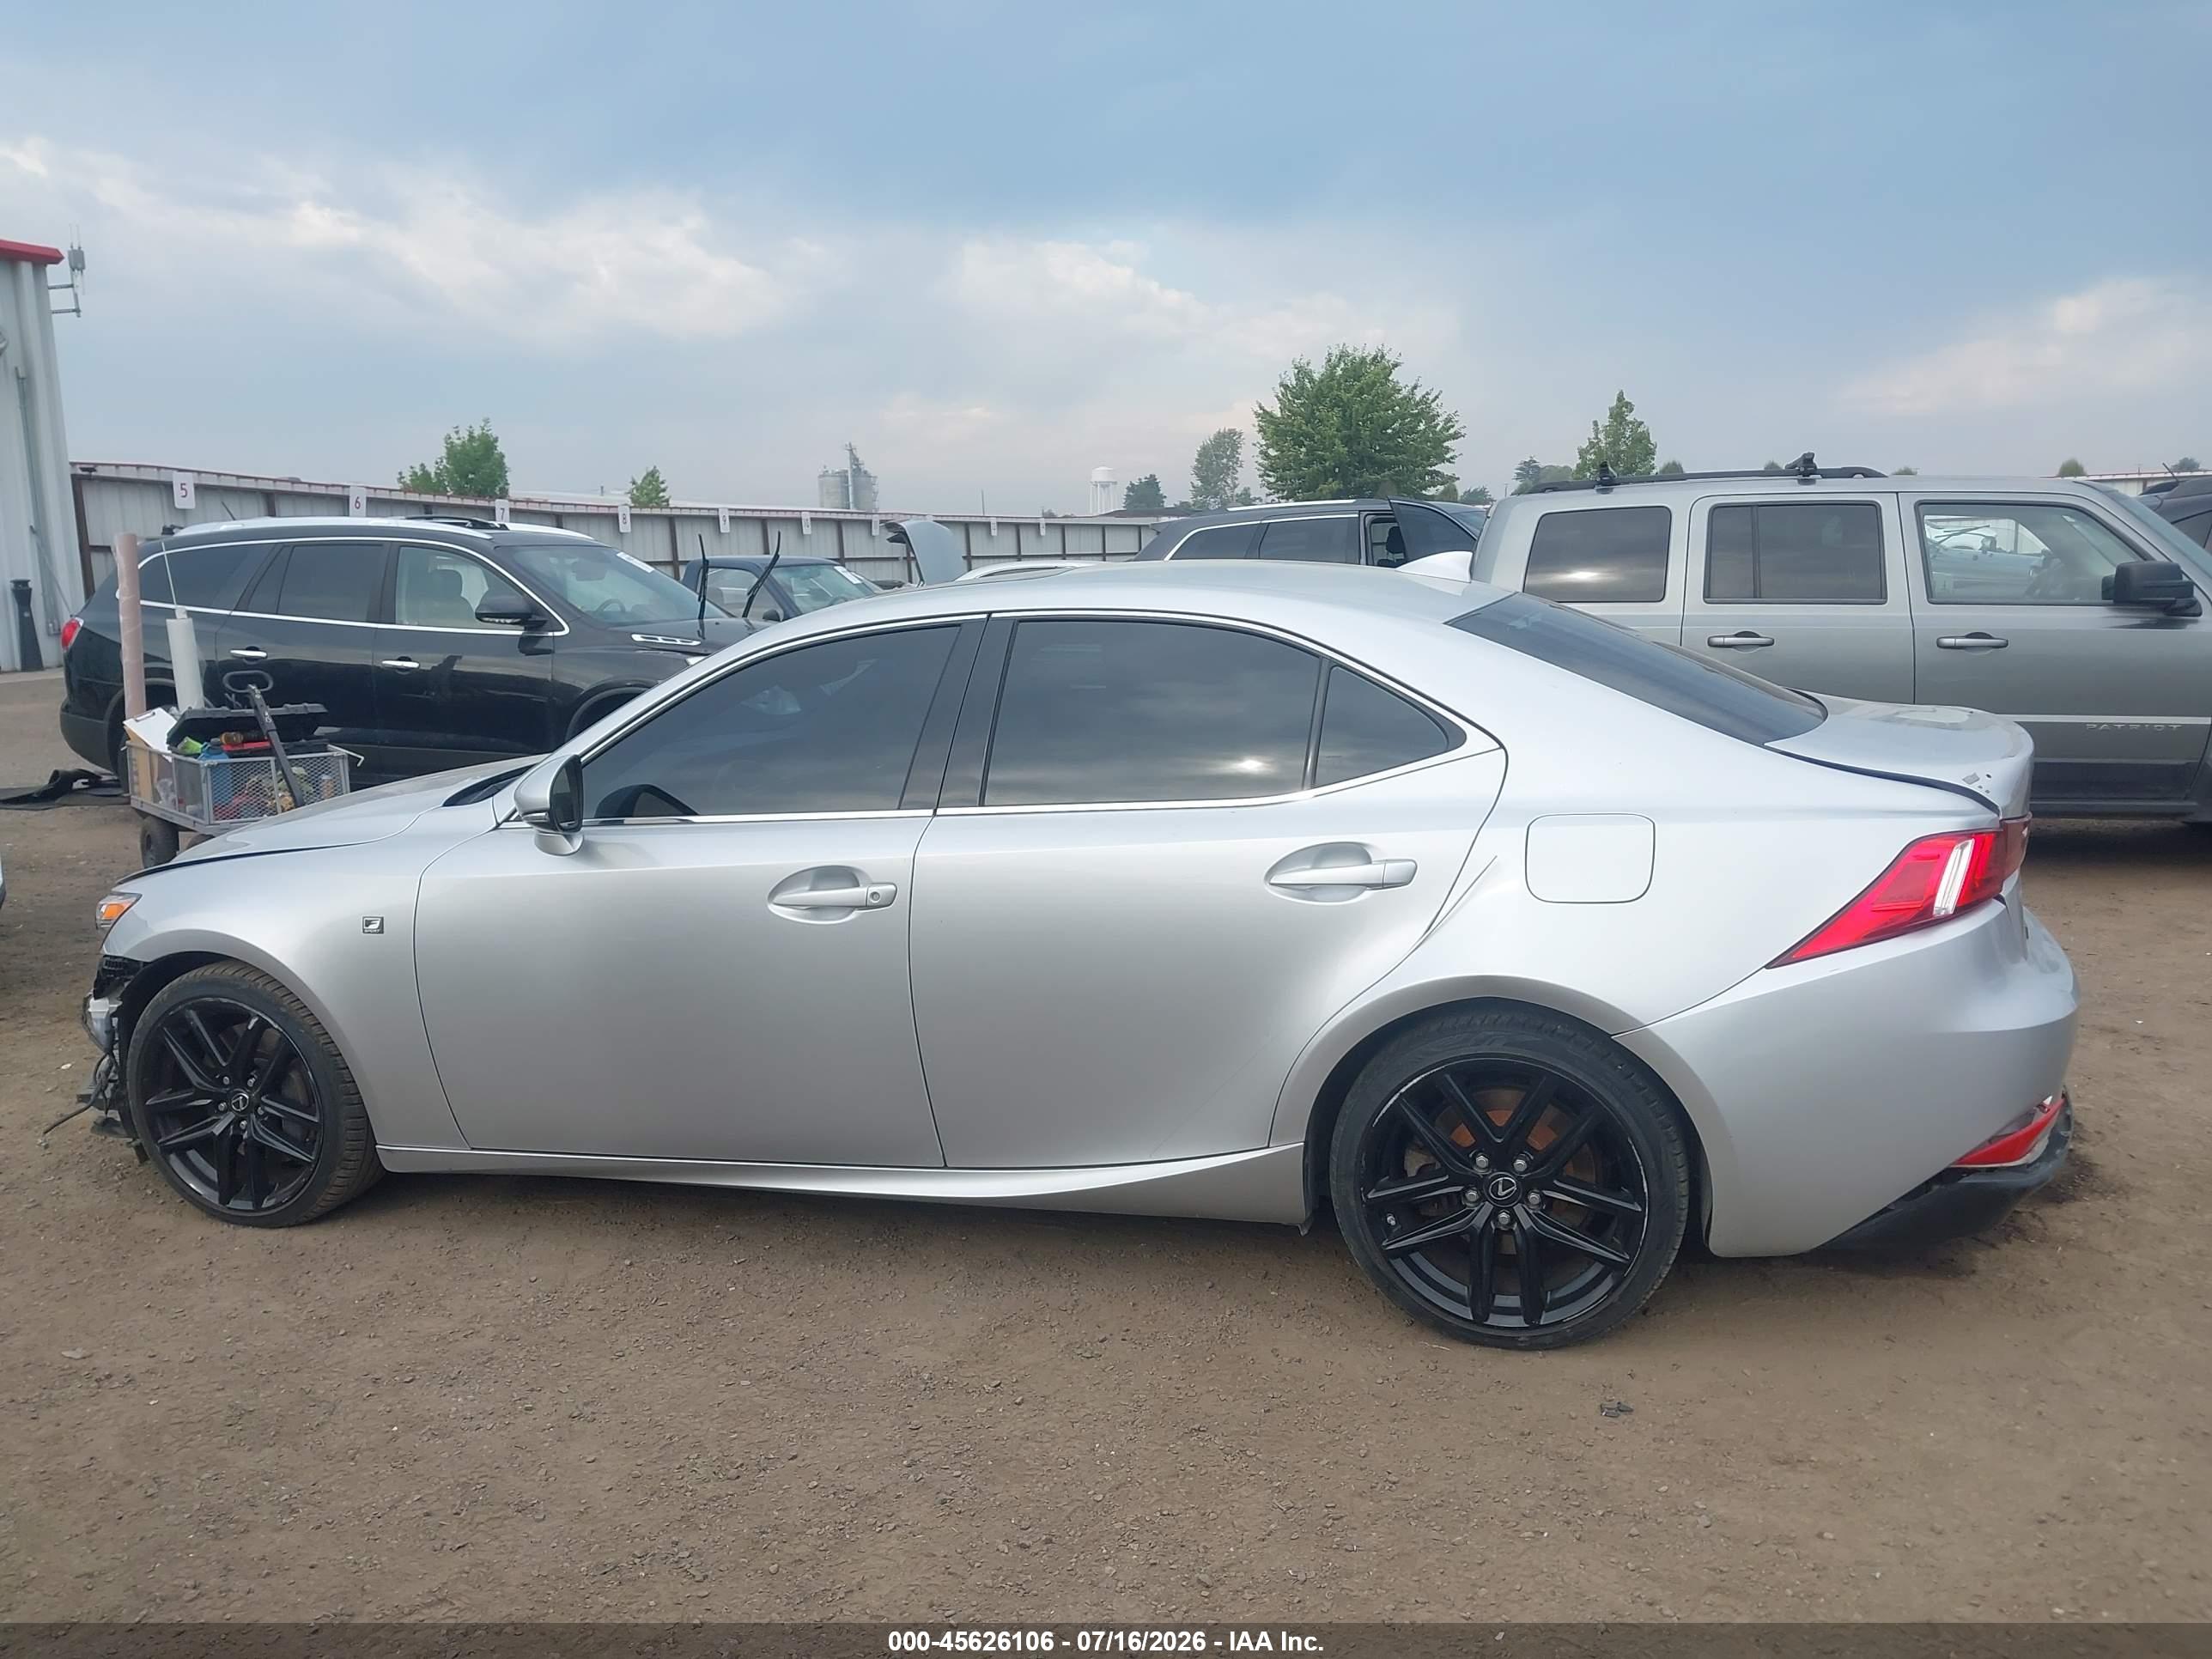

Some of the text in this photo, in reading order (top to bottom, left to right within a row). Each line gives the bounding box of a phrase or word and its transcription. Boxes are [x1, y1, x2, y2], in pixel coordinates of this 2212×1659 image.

[180, 483, 188, 498] 5
[354, 495, 362, 510] 6
[500, 507, 505, 521] 7
[2085, 723, 2184, 732] PATRIOT
